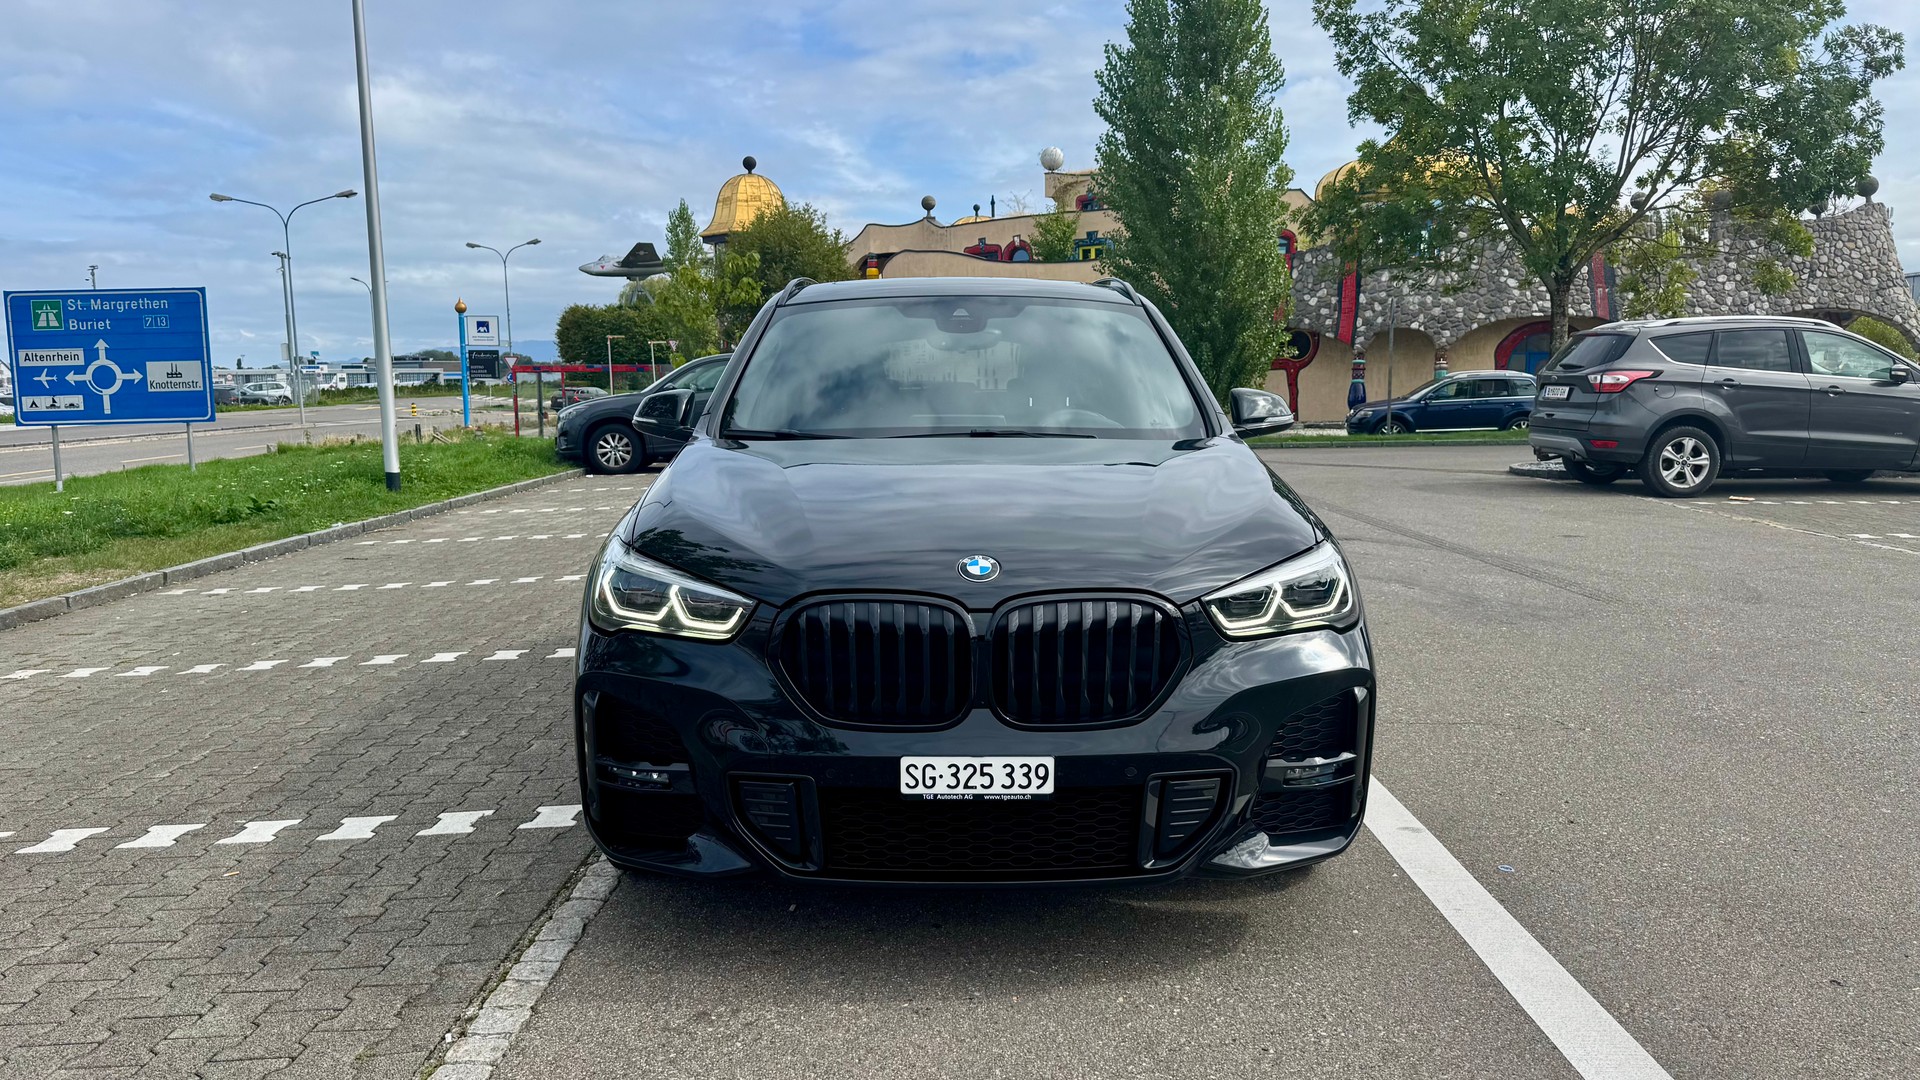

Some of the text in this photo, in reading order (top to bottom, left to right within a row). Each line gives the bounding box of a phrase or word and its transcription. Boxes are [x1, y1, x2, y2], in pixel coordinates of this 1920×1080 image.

[67, 298, 169, 313] St. Margrethen
[69, 318, 111, 331] Buriet
[145, 316, 167, 327] 7 13
[23, 351, 80, 363] Altenrhein
[149, 379, 202, 390] Knotternstr.
[1001, 763, 1050, 790] 339
